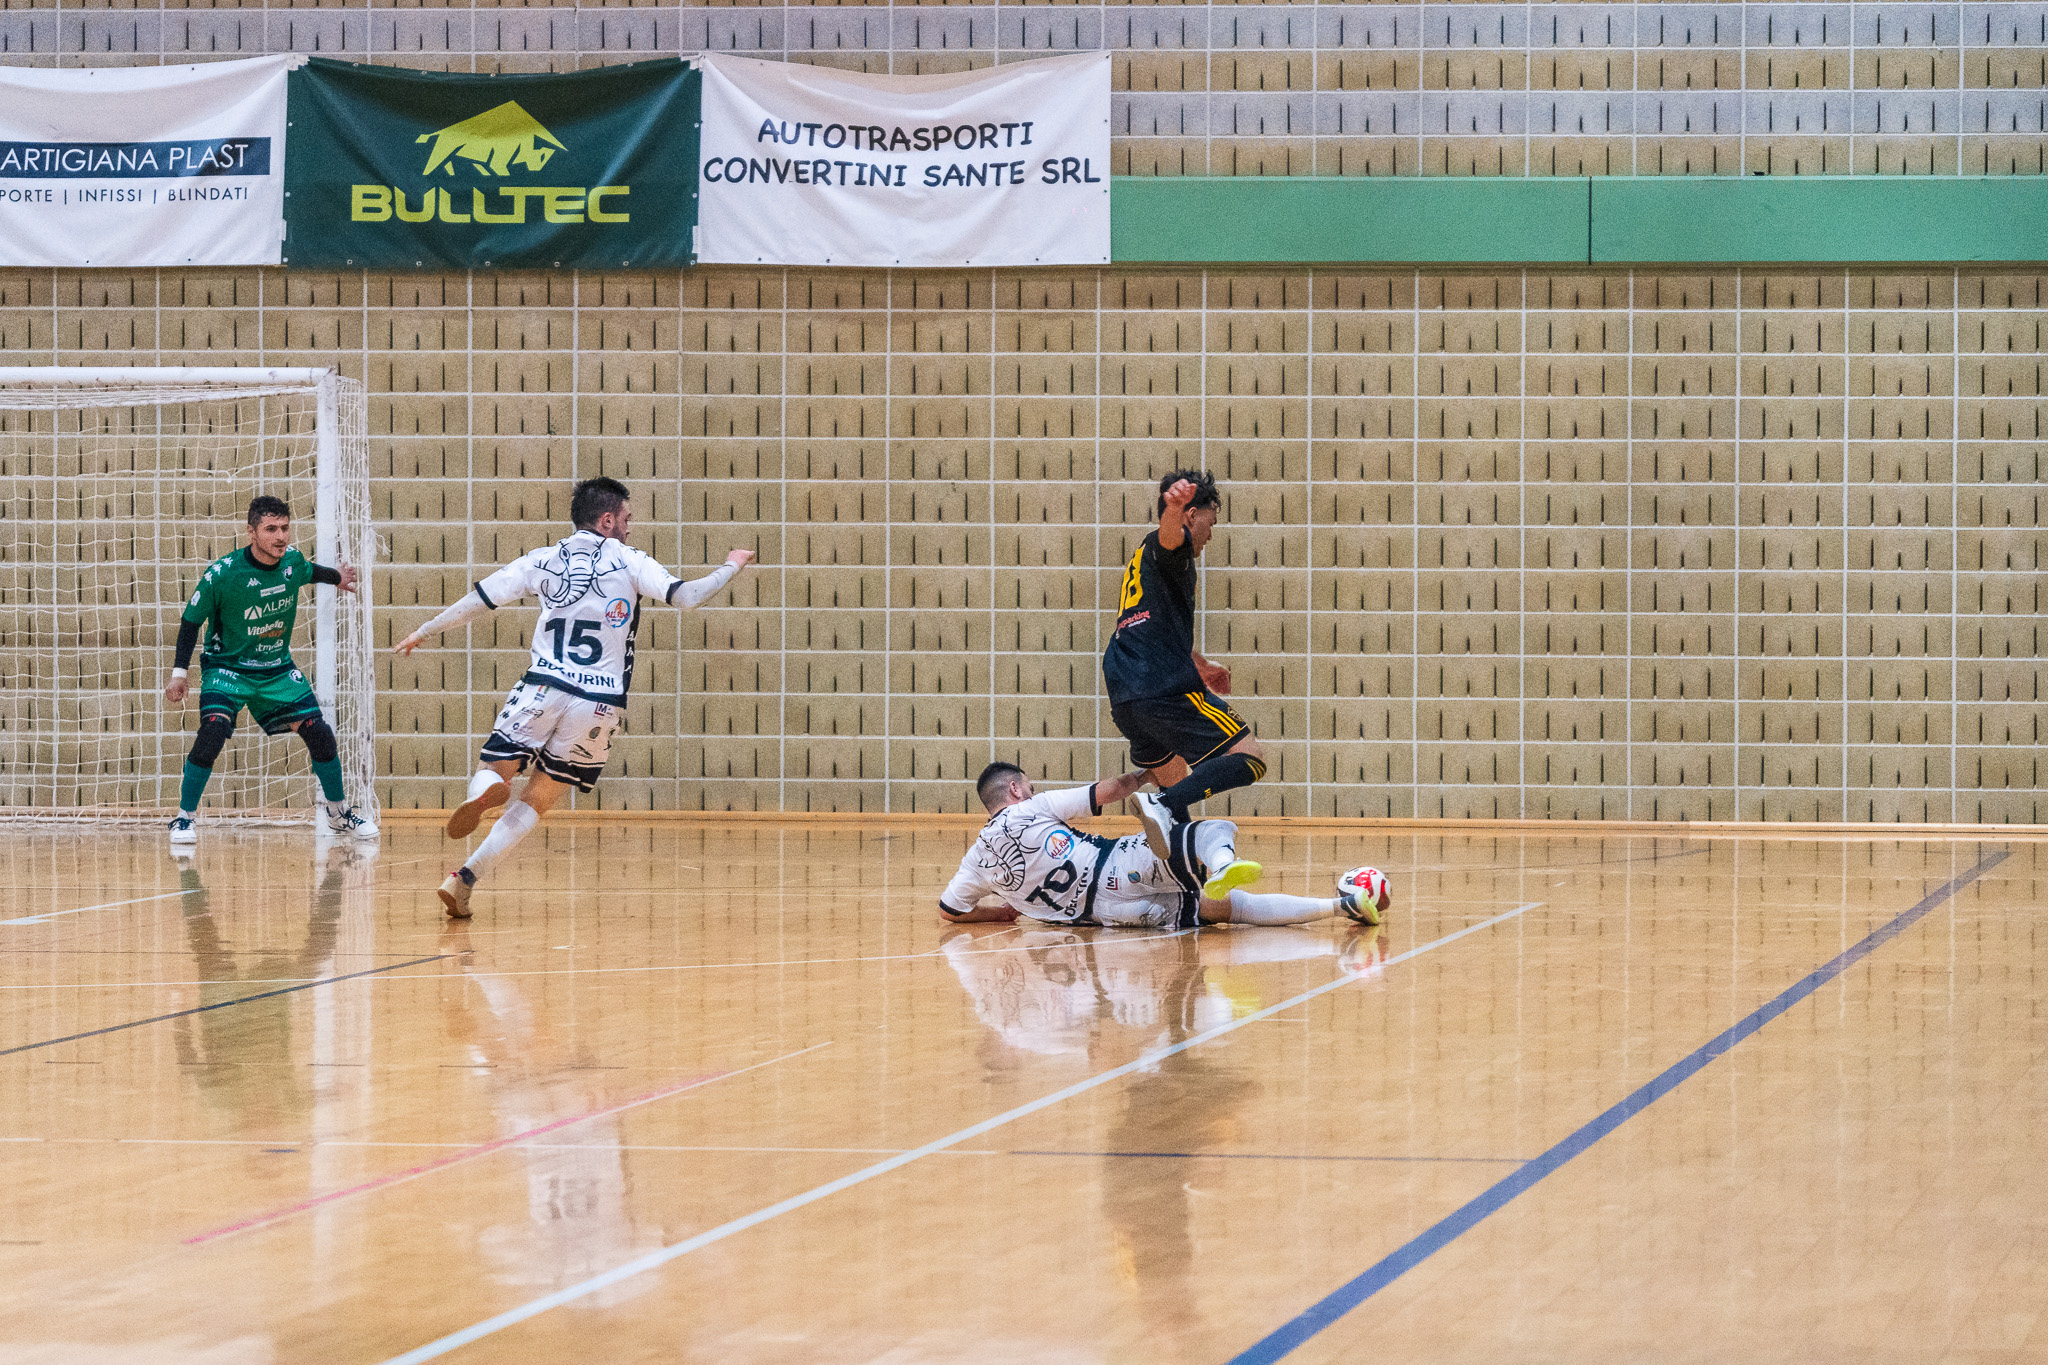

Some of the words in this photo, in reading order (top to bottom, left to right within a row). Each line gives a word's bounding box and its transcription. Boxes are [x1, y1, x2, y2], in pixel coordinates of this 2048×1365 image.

[757, 118, 1033, 152] AUTOTRASPORTI
[0, 148, 159, 172] ARTIGIANA
[169, 144, 249, 170] PLAST
[703, 157, 906, 187] CONVERTINI
[923, 160, 1025, 187] SANTE
[1041, 157, 1101, 184] SRL
[0, 189, 53, 203] PORTE
[79, 188, 142, 202] INFISSI
[168, 187, 248, 202] BLINDATI
[351, 184, 631, 224] BULLTEC
[544, 617, 603, 666] 15
[1025, 860, 1077, 912] 10
